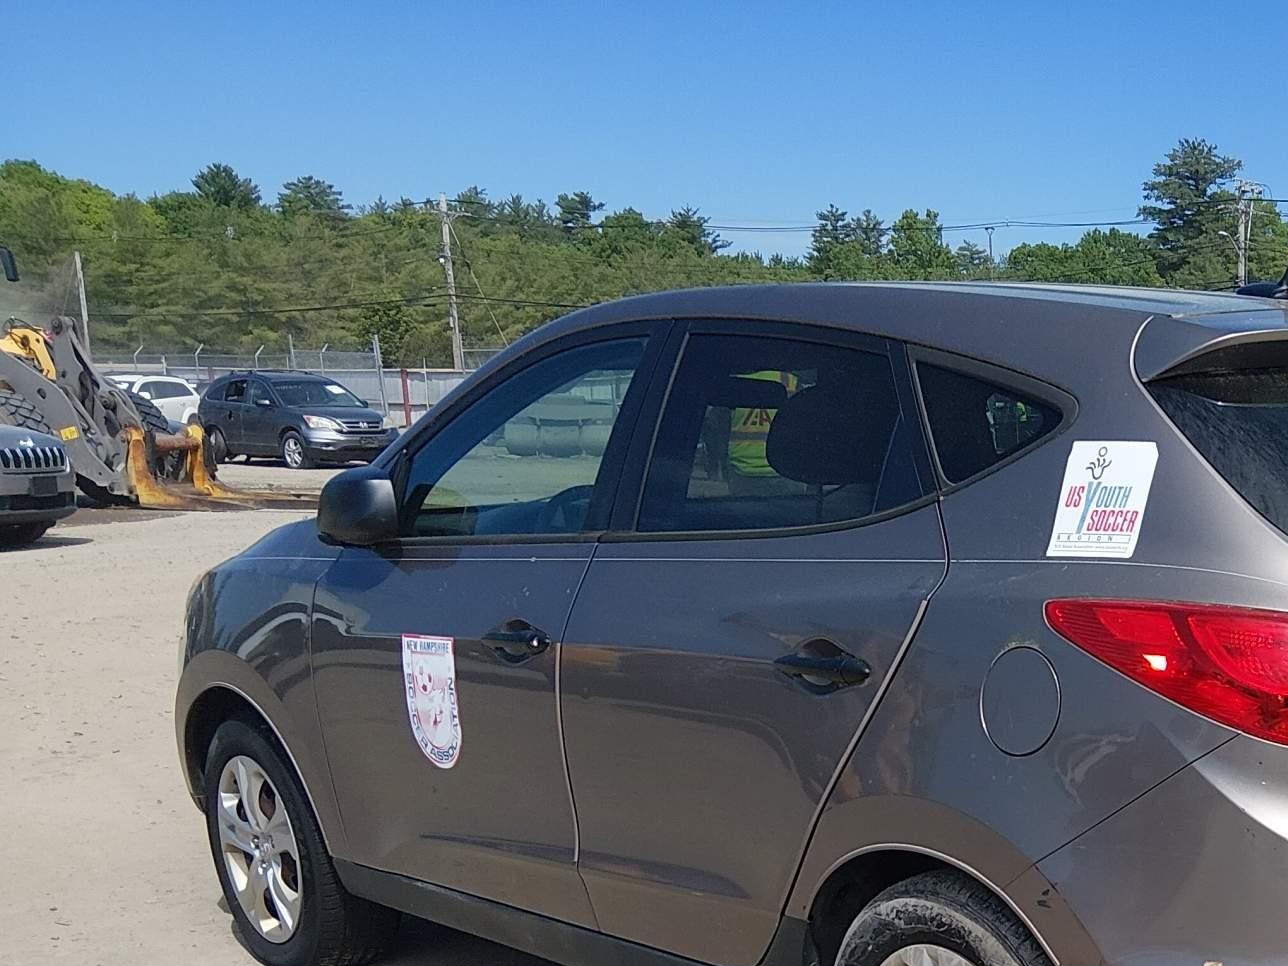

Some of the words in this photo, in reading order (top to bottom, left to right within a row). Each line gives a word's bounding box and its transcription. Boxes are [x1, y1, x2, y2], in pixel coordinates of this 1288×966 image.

[1065, 486, 1085, 508] US
[1076, 481, 1133, 534] YOUTH
[1087, 509, 1139, 533] SOCCER
[406, 640, 418, 651] NEW
